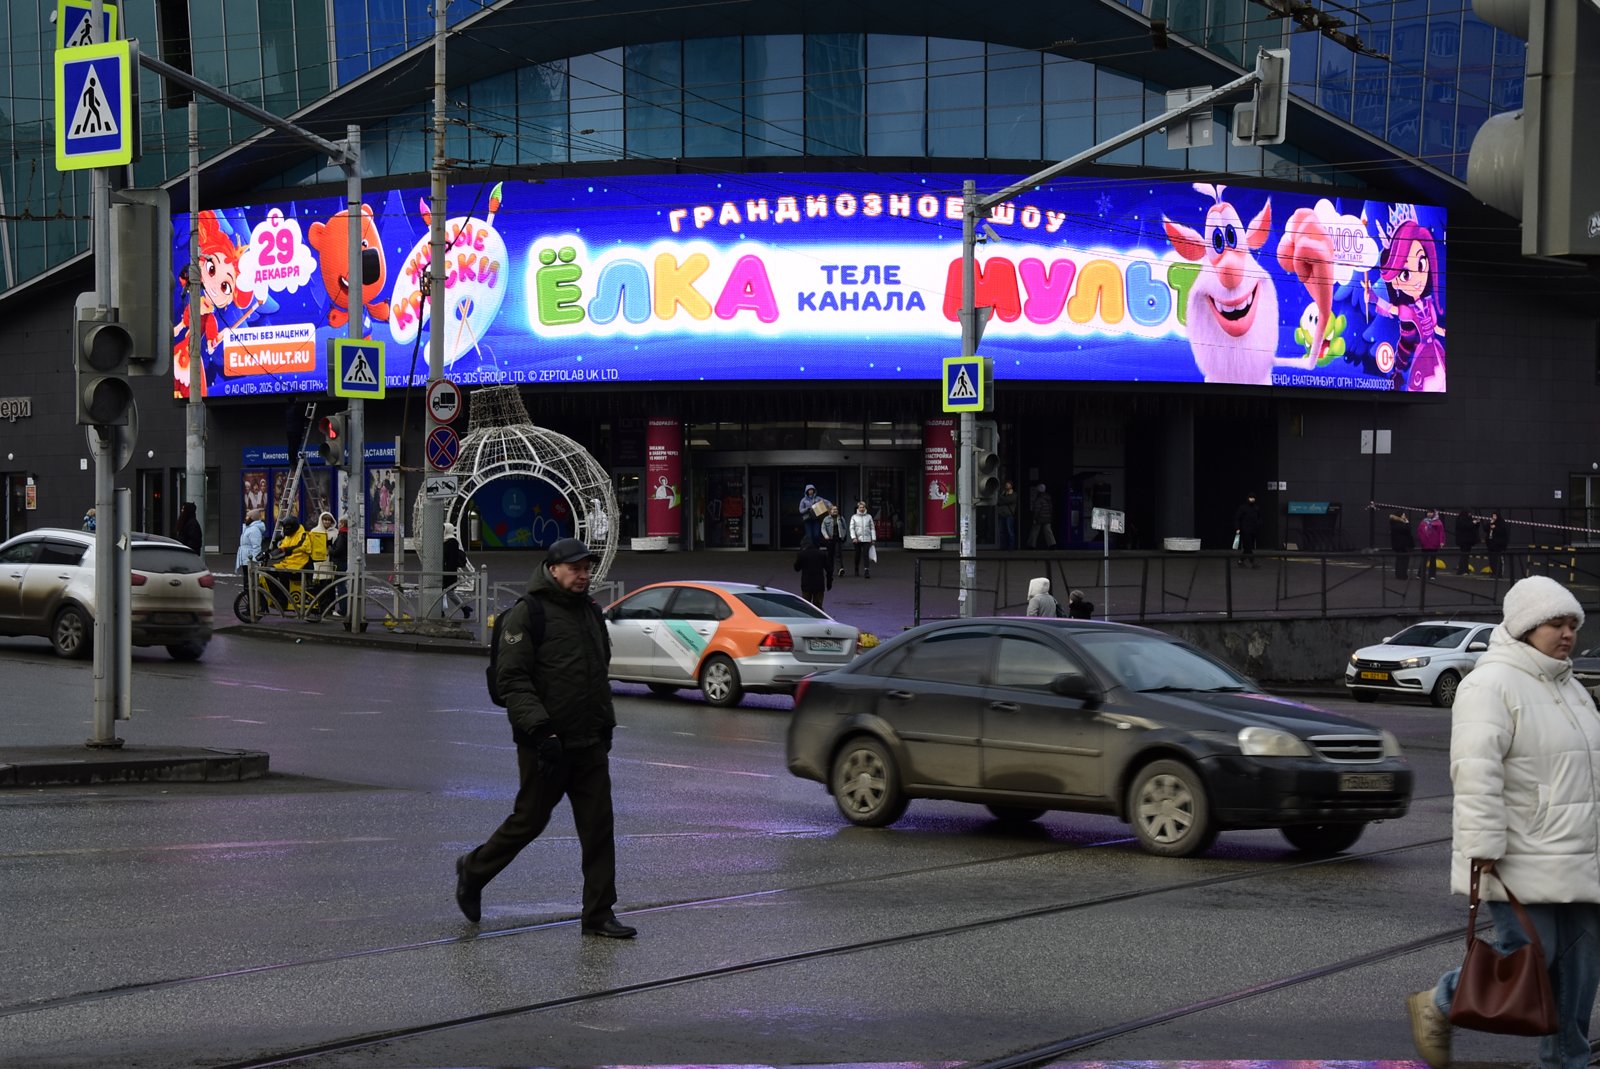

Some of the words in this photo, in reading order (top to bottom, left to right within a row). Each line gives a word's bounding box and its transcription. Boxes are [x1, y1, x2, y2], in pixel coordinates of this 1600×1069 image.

[669, 193, 965, 232] ГРАНДИОЗНОЕ
[986, 202, 1066, 233] ШОУ
[258, 228, 294, 266] 29
[254, 265, 300, 284] ДЕКАБРЯ
[820, 264, 902, 286] ТЕЛЕ
[536, 246, 780, 326] ЁЛКА
[797, 290, 926, 312] КАНАЛА
[229, 332, 259, 343] БИЛЕТЫ
[260, 331, 274, 341] БЕЗ
[275, 328, 310, 340] НАЦЕНКИ
[463, 372, 477, 383] 3DS
[539, 369, 584, 381] ZEPTOLAB
[586, 369, 599, 380] UK
[601, 368, 620, 380] LTD.
[1338, 377, 1353, 388] ОГРН
